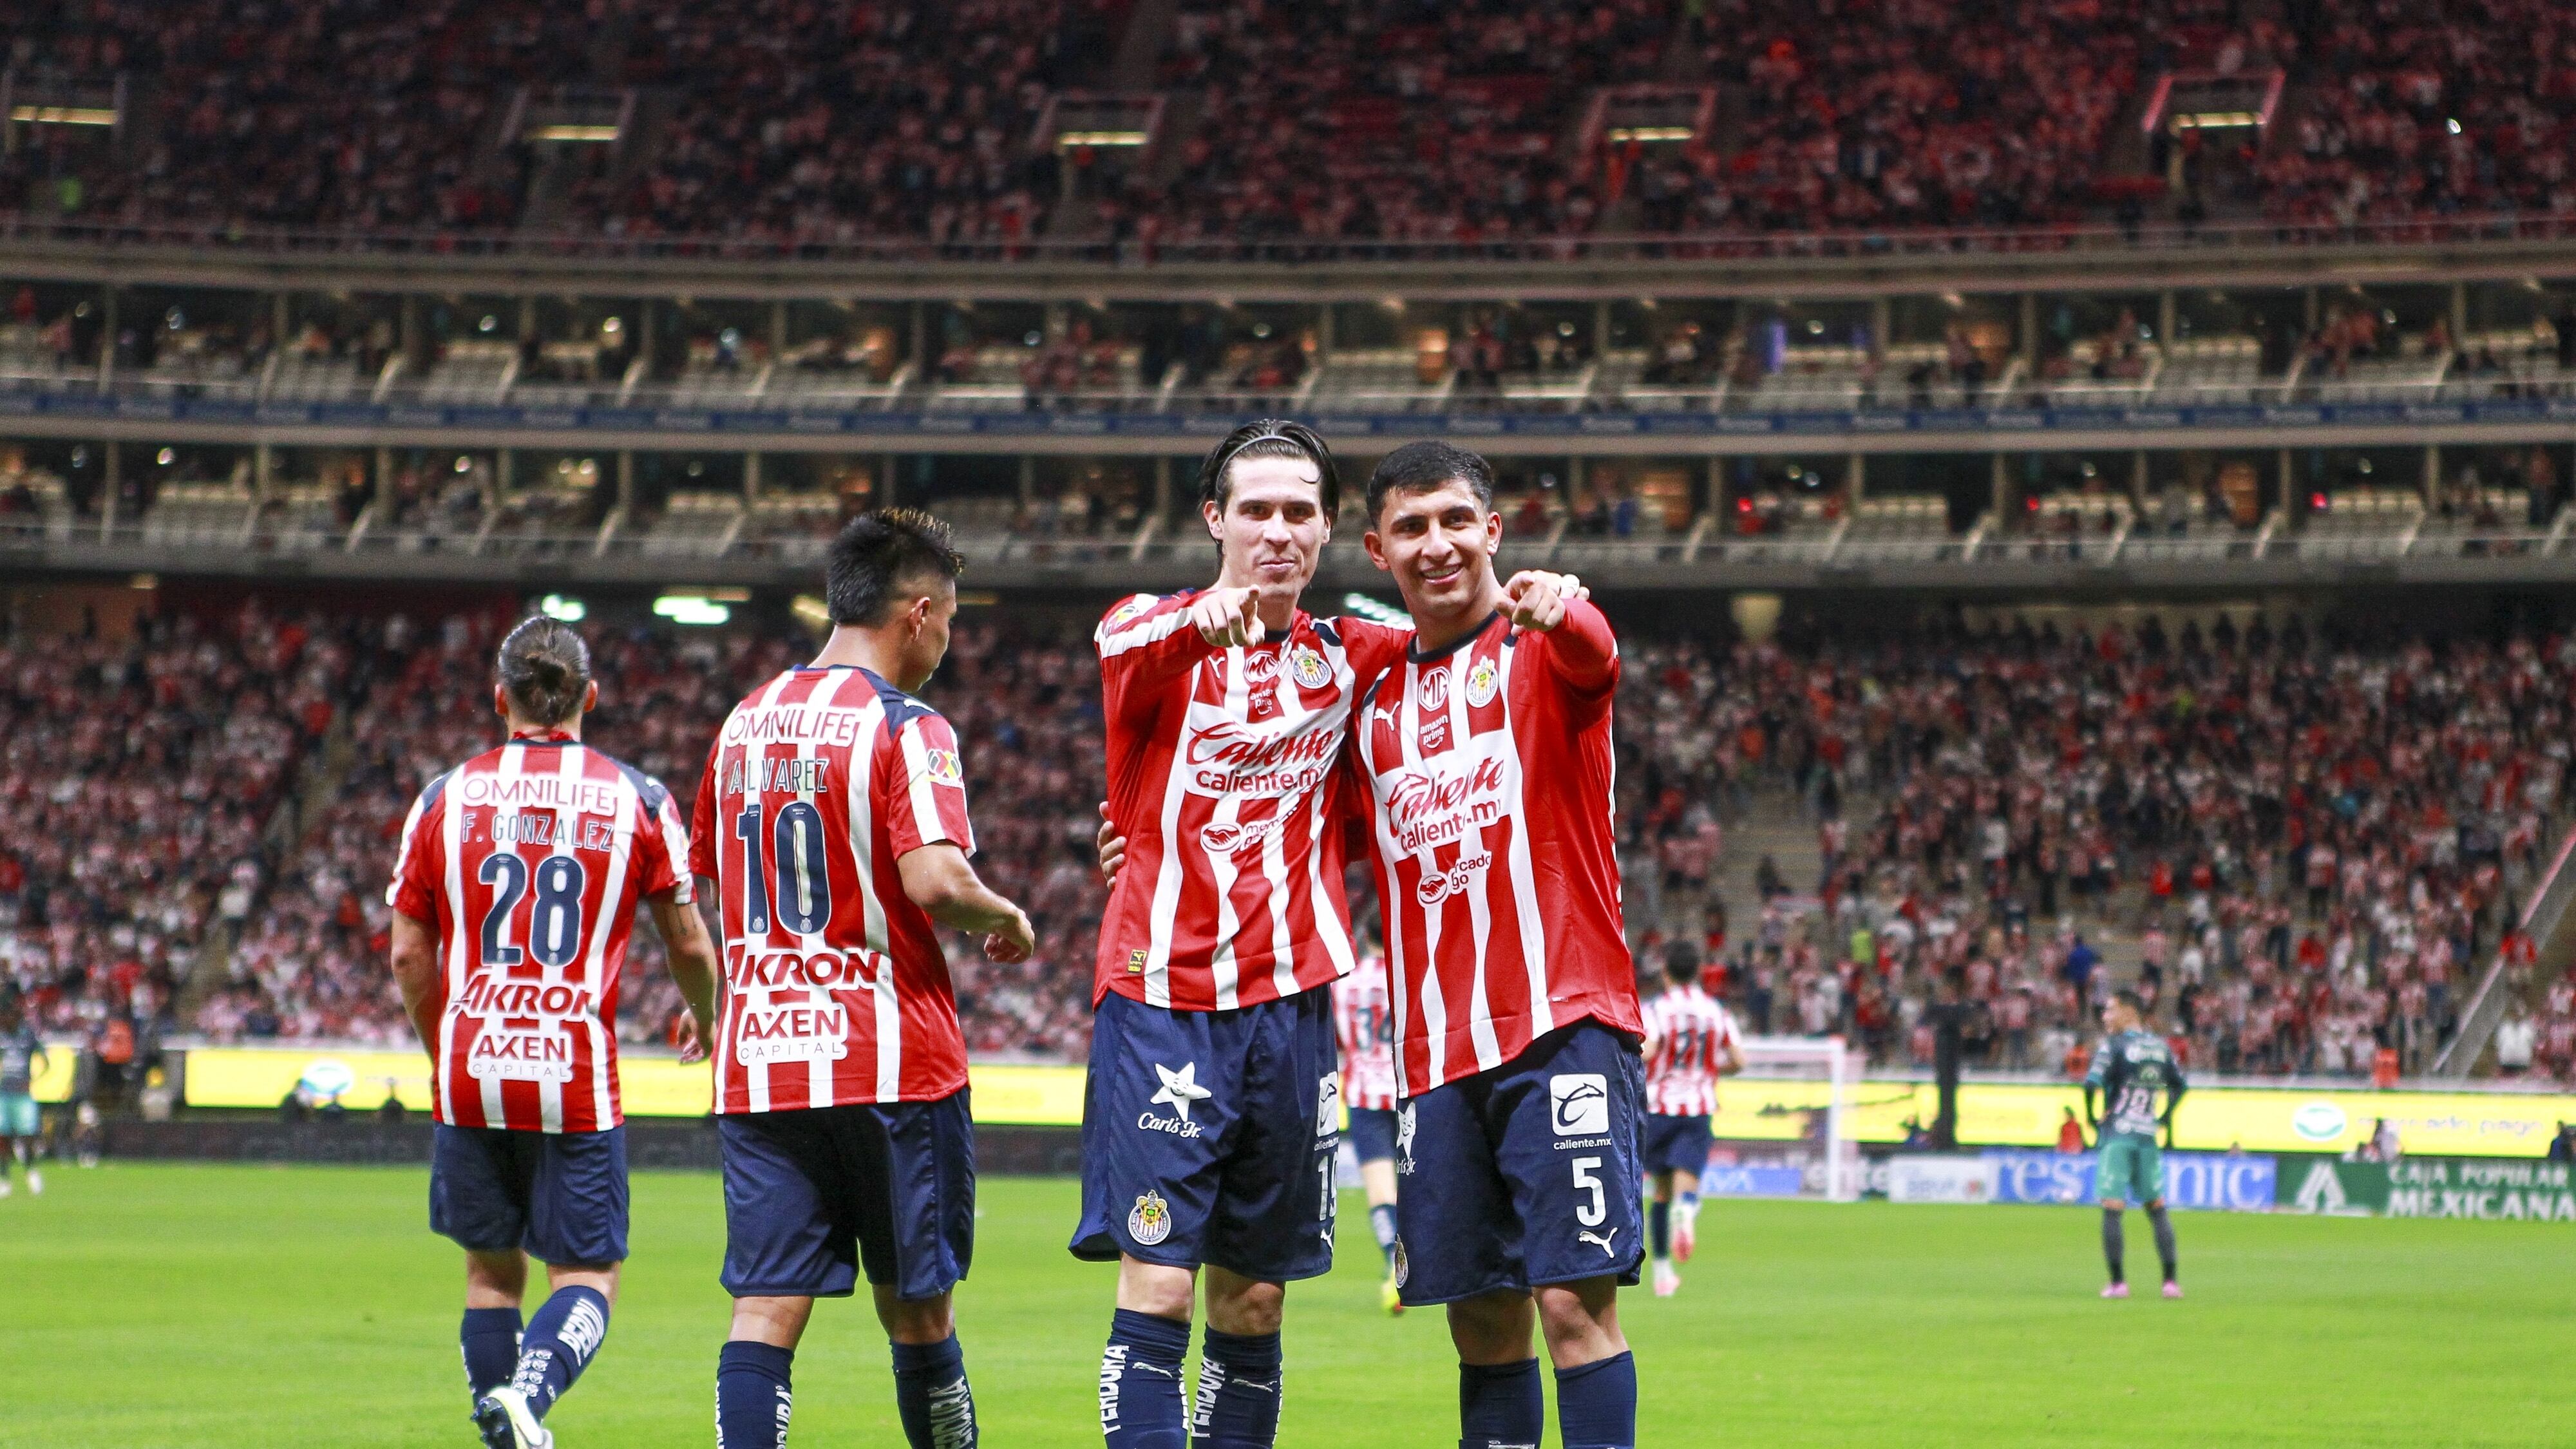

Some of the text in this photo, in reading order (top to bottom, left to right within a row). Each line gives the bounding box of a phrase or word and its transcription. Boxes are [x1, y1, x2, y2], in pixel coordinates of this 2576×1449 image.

[729, 709, 856, 742] OMNILIFE
[1423, 726, 1445, 746] prime
[728, 758, 829, 794] ALVAREZ
[1196, 766, 1325, 793] caliente.m
[464, 778, 610, 811] OMNILIFE
[462, 813, 614, 852] F. GONZALEZ
[1400, 799, 1501, 852] calient.m
[736, 801, 831, 936] 10
[478, 853, 585, 966] 28
[728, 944, 881, 987] AKRON
[741, 1009, 841, 1042] AXEN
[473, 1035, 567, 1061] AXEN
[741, 1043, 841, 1060] CAPITAL
[473, 1063, 567, 1078] CAPITAL
[1138, 1112, 1202, 1138] Carl's Jr.
[1553, 1137, 1611, 1150] caliente.mx
[1572, 1157, 1607, 1227] 5
[2385, 1190, 2576, 1221] MEXICANA
